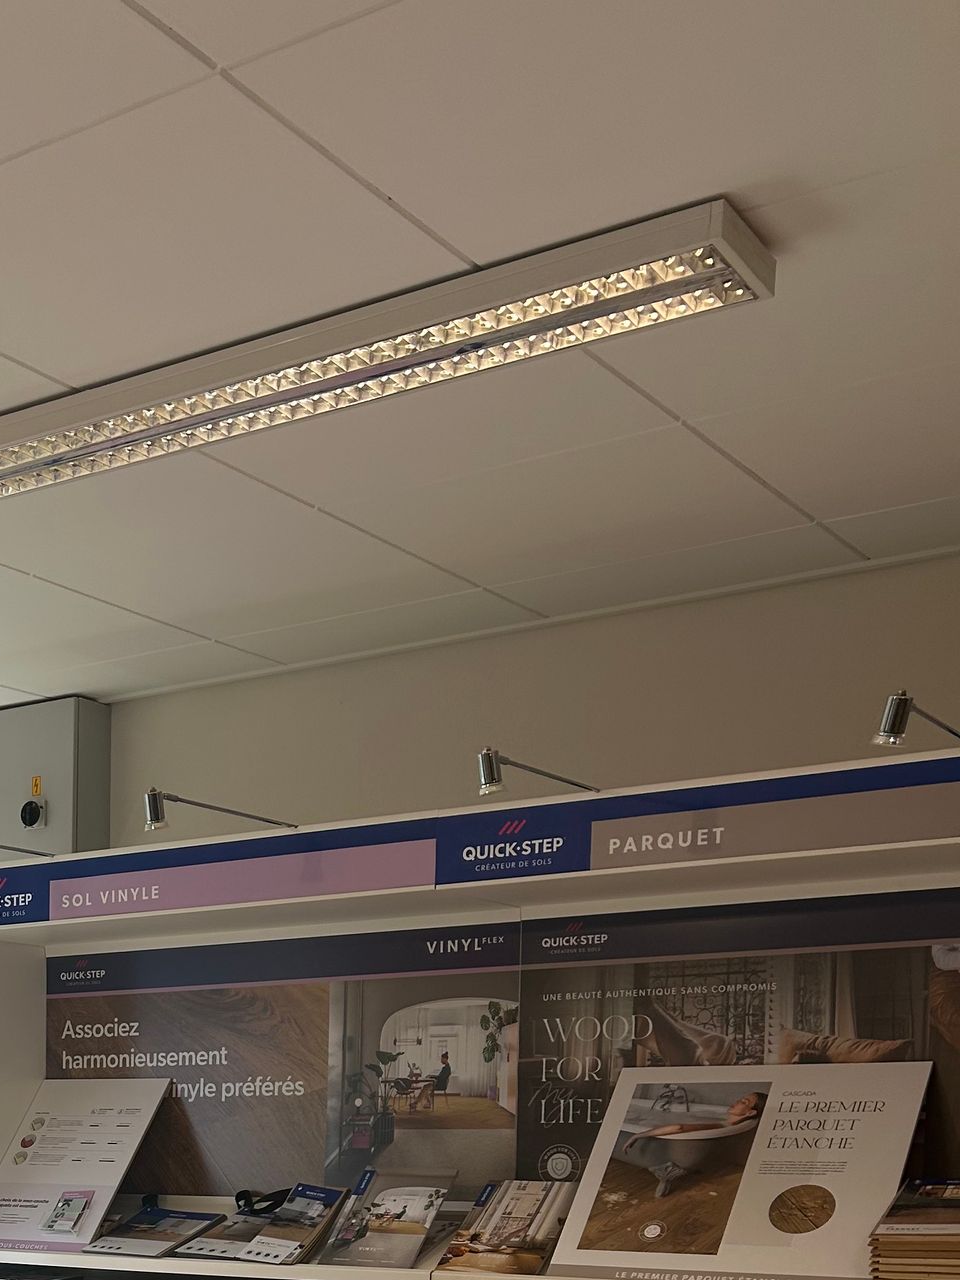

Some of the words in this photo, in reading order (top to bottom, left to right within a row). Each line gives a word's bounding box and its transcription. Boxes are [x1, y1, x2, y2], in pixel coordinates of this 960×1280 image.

[609, 827, 726, 855] PARQUET
[475, 861, 516, 872] CRÉATEUR
[519, 860, 529, 868] DE
[532, 857, 552, 867] SOLS
[61, 892, 92, 908] SOL
[100, 885, 160, 904] VINYLE
[12, 909, 26, 917] SOLS
[543, 993, 562, 1002] UNE
[565, 990, 603, 1001] BEAUTÉ
[606, 987, 677, 999] AUTHENTIQUE
[680, 985, 708, 995] SANS
[711, 982, 777, 994] COMPROMIS
[61, 1017, 140, 1040] Associez
[542, 1014, 653, 1043] WOOD
[62, 1046, 228, 1070] harmonieusement
[541, 1056, 603, 1082] FOR
[221, 1075, 305, 1102] préférés
[539, 1098, 603, 1125] LIFE
[778, 1101, 800, 1113] LE
[805, 1100, 886, 1113] PREMIER
[772, 1118, 861, 1131] PARQUET
[766, 1135, 855, 1150] ÉTANCHE
[615, 1271, 629, 1280] LE
